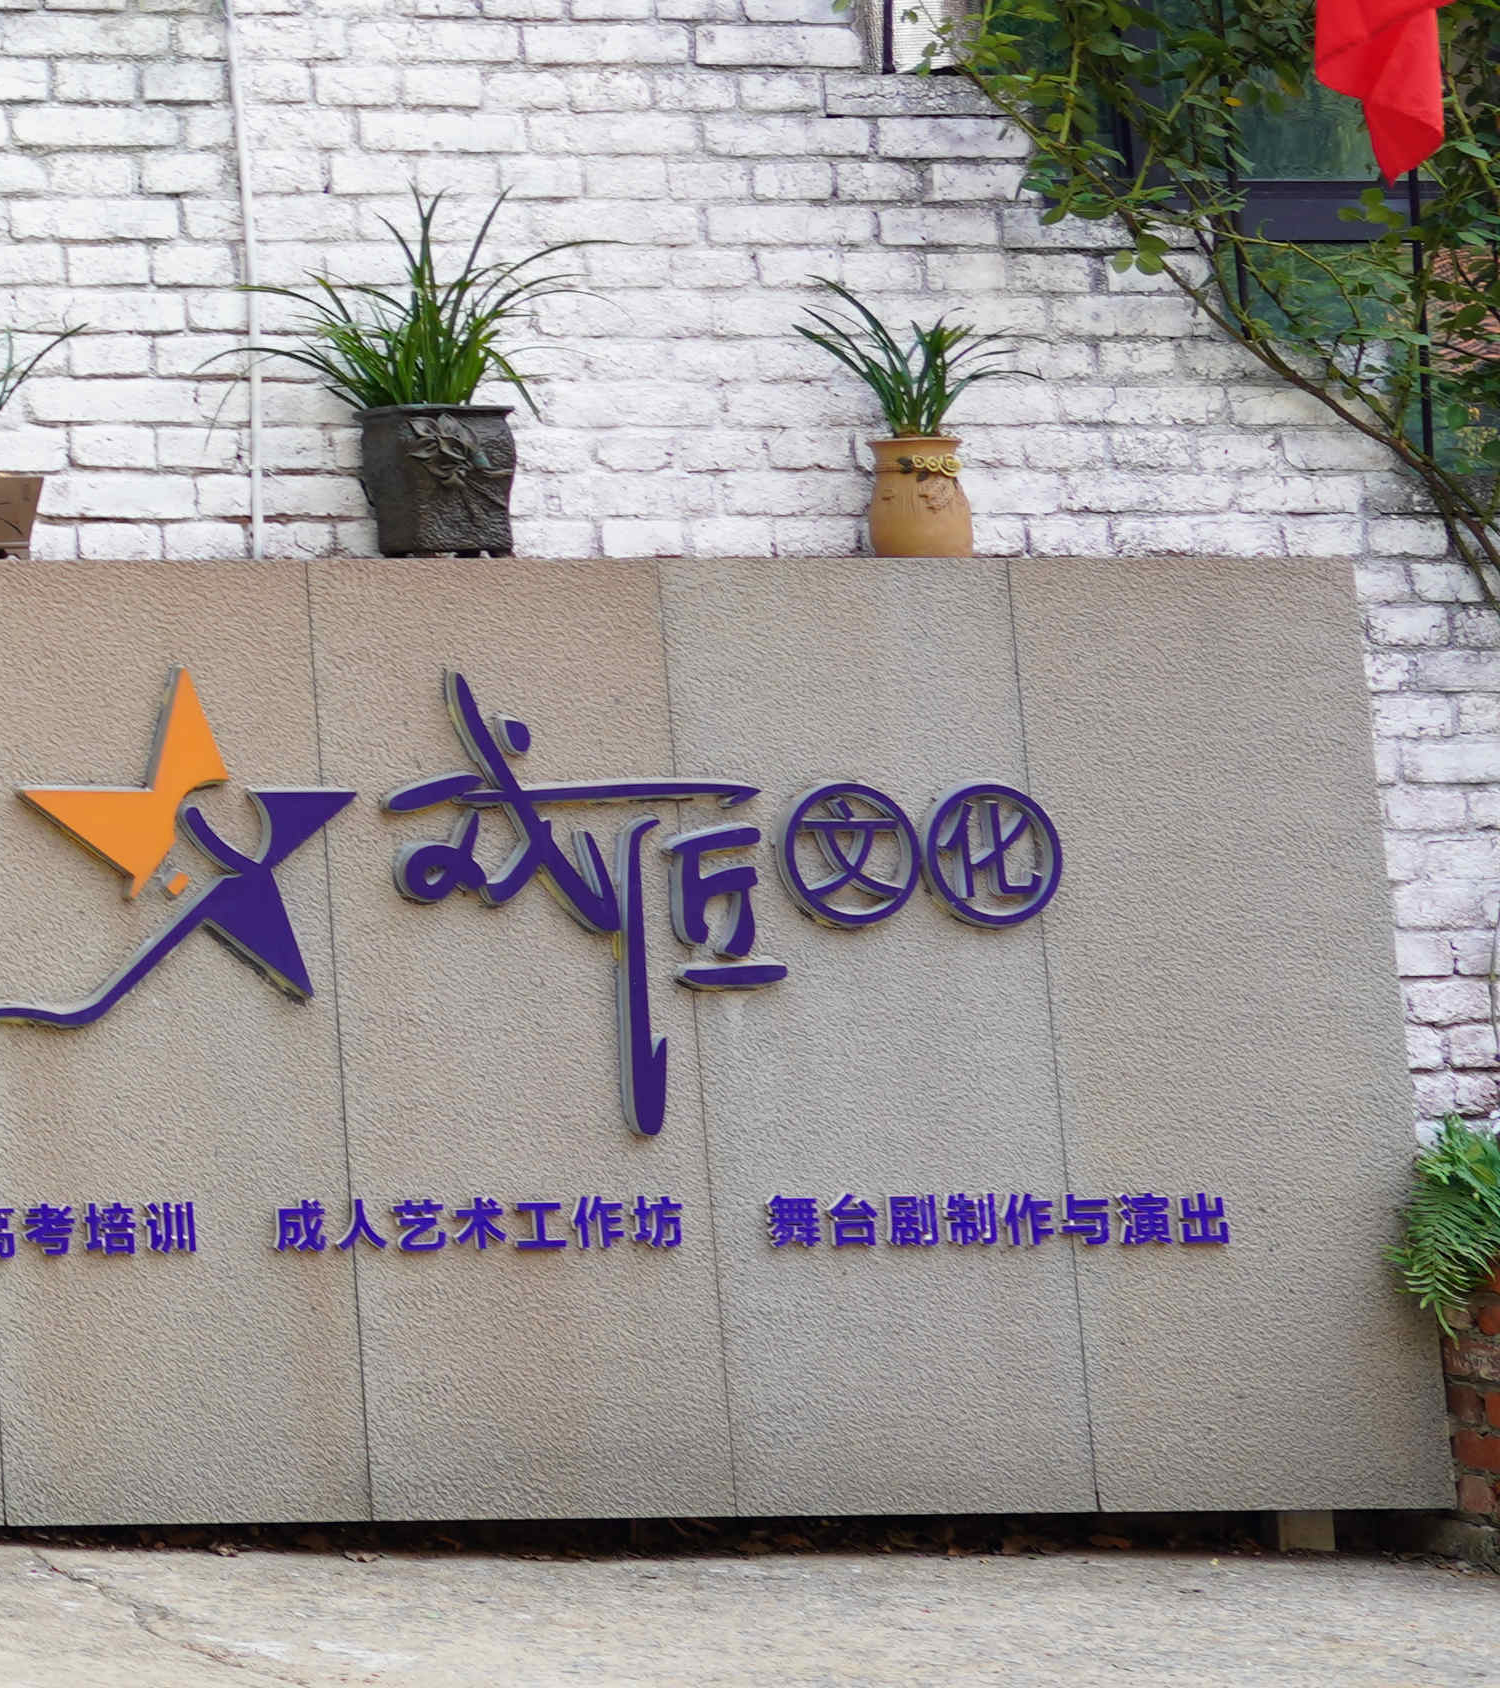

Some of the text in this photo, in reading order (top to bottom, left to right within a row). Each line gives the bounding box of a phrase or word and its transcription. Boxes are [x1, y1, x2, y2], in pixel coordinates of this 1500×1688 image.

[276, 1195, 684, 1252] 成人艺术工作坊
[767, 1191, 1231, 1249] 舞台剧制作与演出
